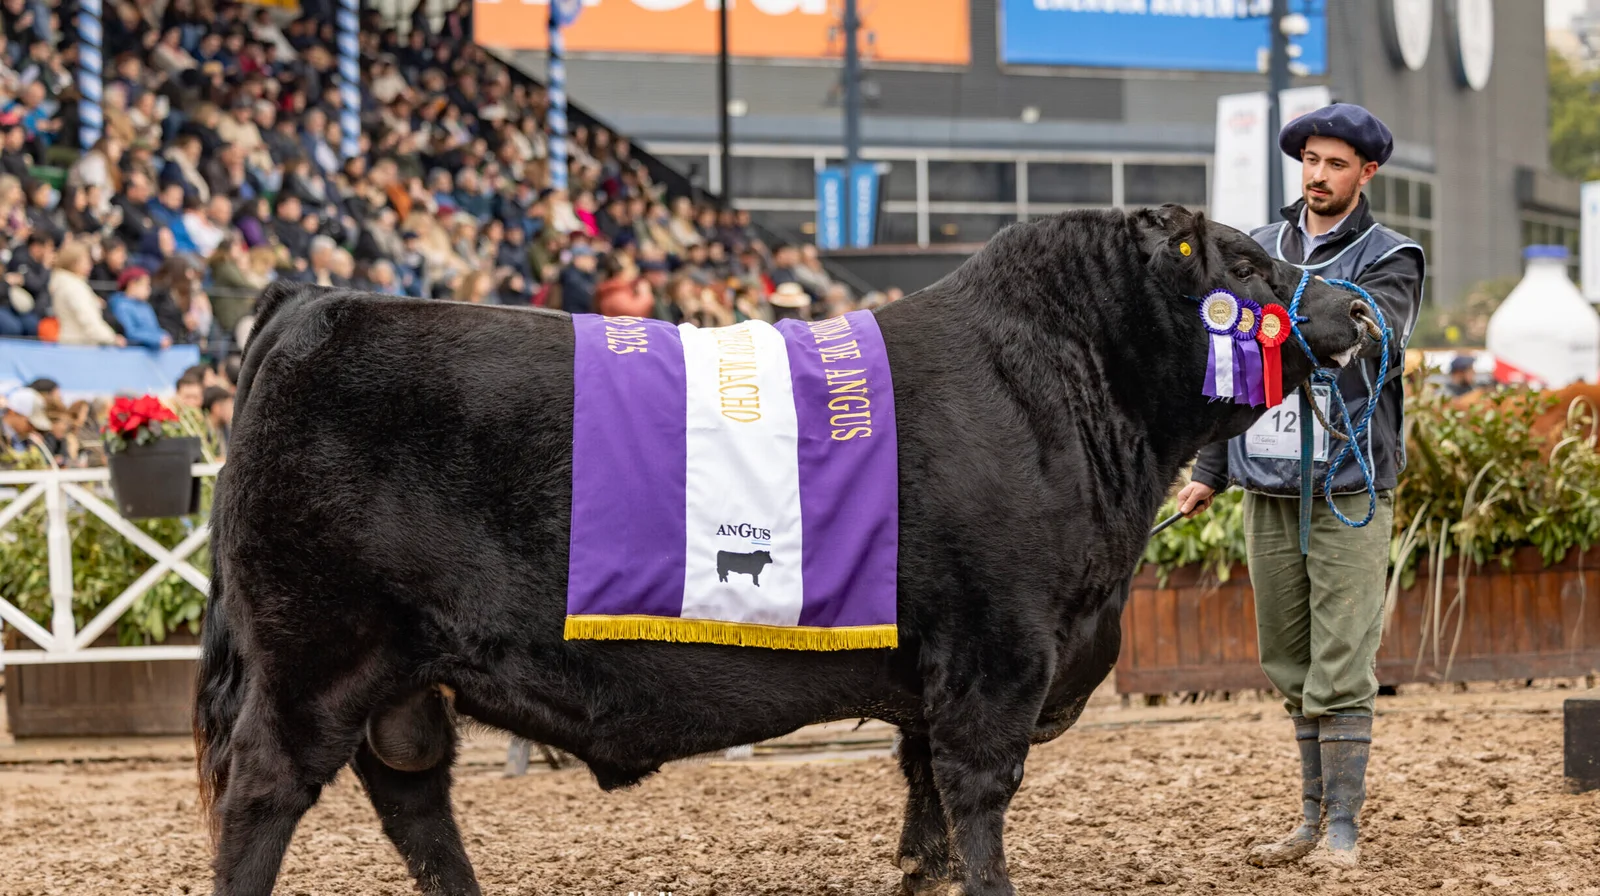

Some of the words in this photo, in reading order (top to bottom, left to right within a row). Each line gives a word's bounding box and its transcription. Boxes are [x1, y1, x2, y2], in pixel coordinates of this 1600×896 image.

[605, 326, 648, 355] 2025
[818, 340, 861, 363] DE
[719, 358, 761, 423] MACHO
[824, 368, 872, 441] ANGUS
[1272, 410, 1300, 433] 12
[716, 523, 771, 540] ANGUS
